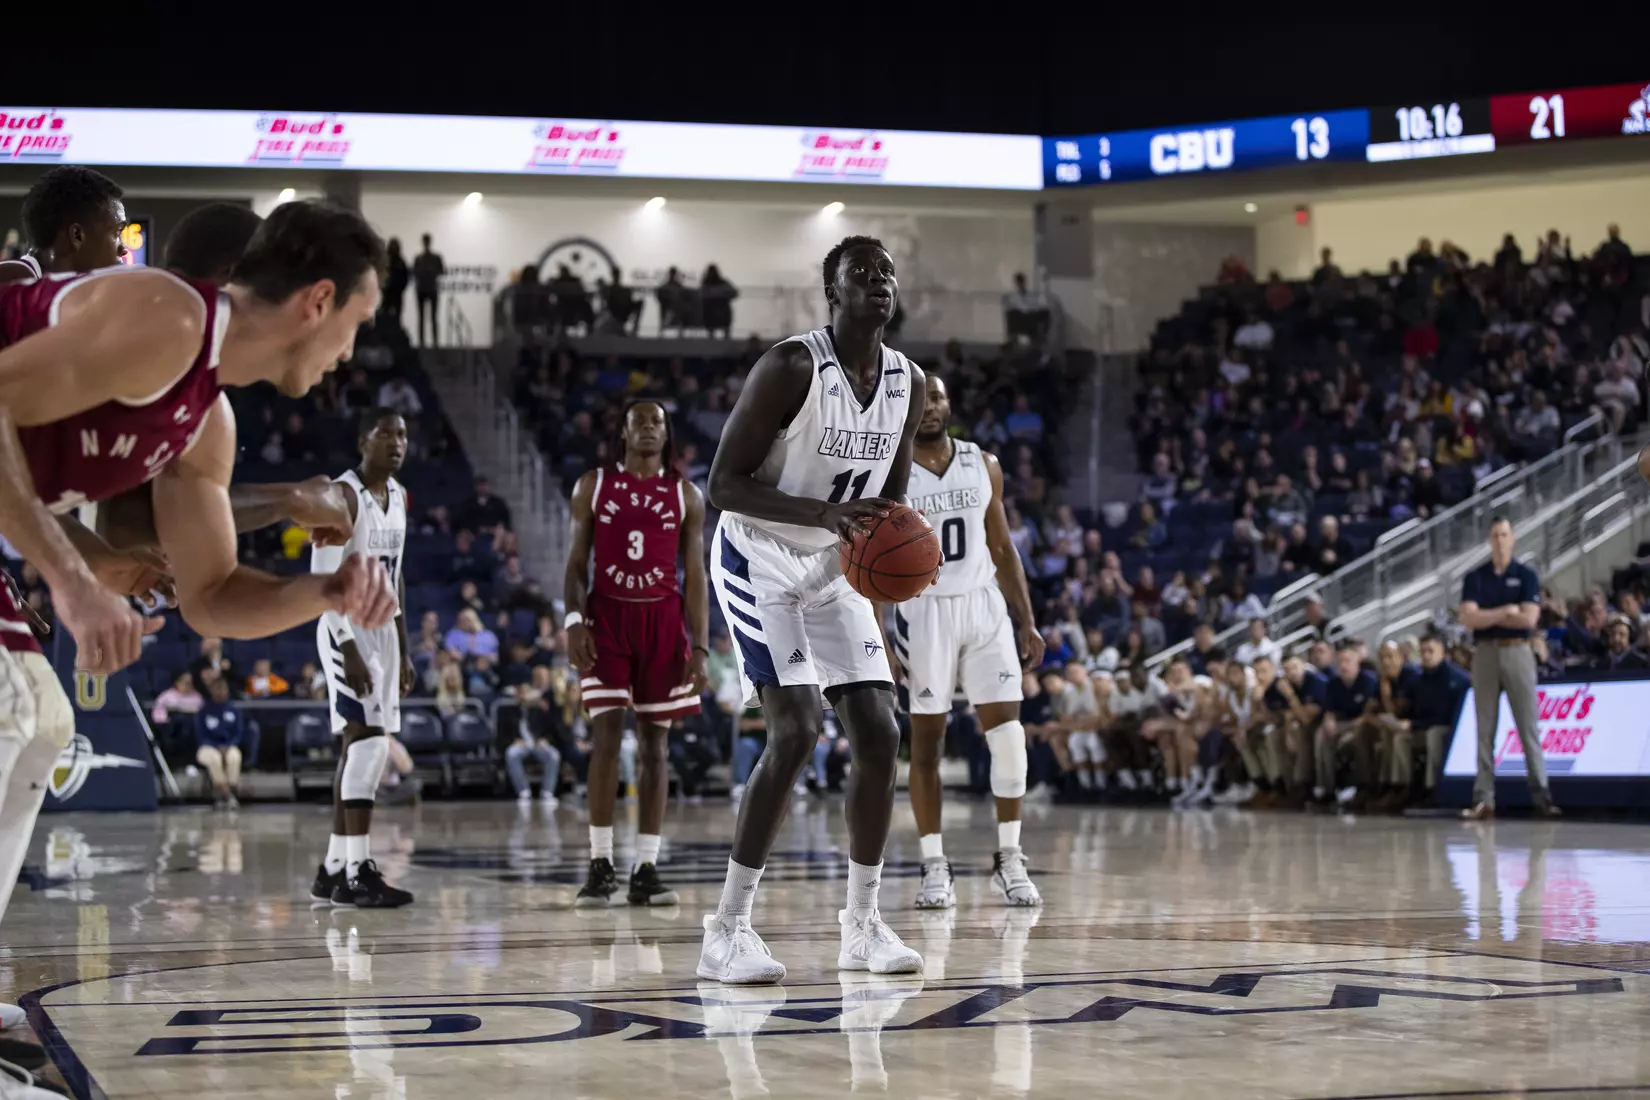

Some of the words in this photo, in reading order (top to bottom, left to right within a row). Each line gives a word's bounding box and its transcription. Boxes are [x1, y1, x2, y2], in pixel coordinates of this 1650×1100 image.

[1396, 102, 1463, 140] 10:16
[1529, 94, 1565, 139] 21
[1150, 128, 1235, 174] CBU
[1291, 117, 1330, 160] 13
[885, 388, 905, 399] WAC
[818, 427, 898, 460] LANCERS
[827, 469, 872, 503] 11
[630, 491, 677, 531] STATE
[627, 530, 644, 561] 3
[941, 516, 966, 563] 0
[605, 564, 665, 590] AGGIES
